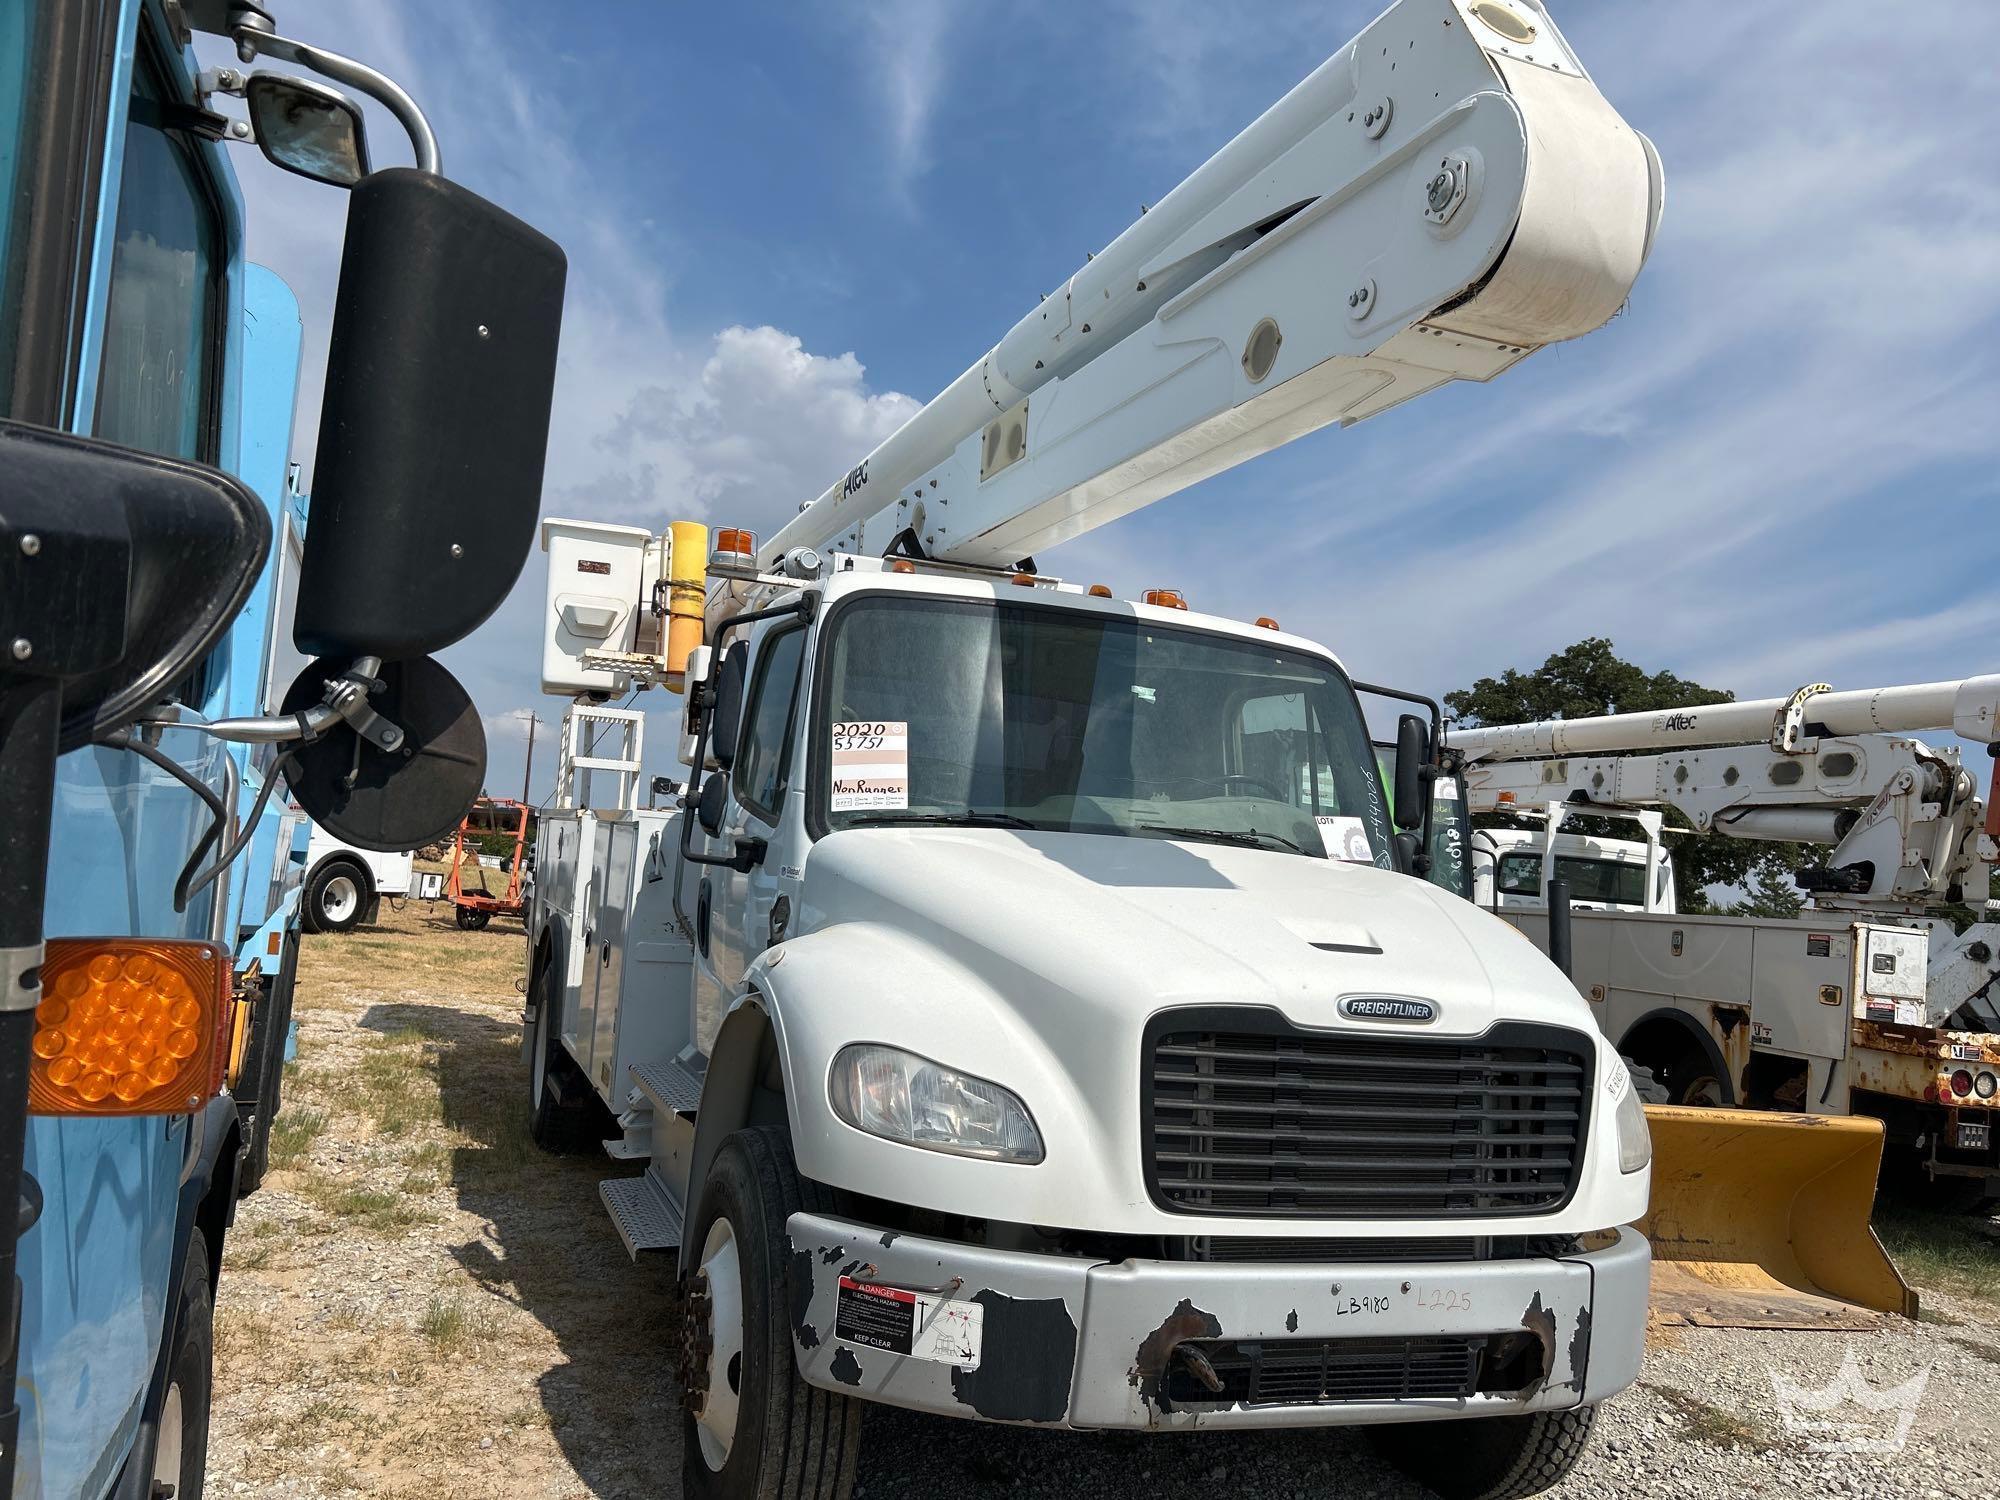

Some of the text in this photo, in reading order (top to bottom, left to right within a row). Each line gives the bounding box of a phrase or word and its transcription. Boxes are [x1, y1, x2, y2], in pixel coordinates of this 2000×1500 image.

[833, 723, 886, 737] 2020
[1665, 713, 1697, 731] Altec
[1351, 1001, 1430, 1017] FREIGHTLINER
[852, 1291, 900, 1308] ELECTRICAL HAZARD
[865, 1285, 895, 1299] DANGER
[1336, 1296, 1390, 1315] LB9180
[854, 1333, 892, 1349] KEEP CLEAR
